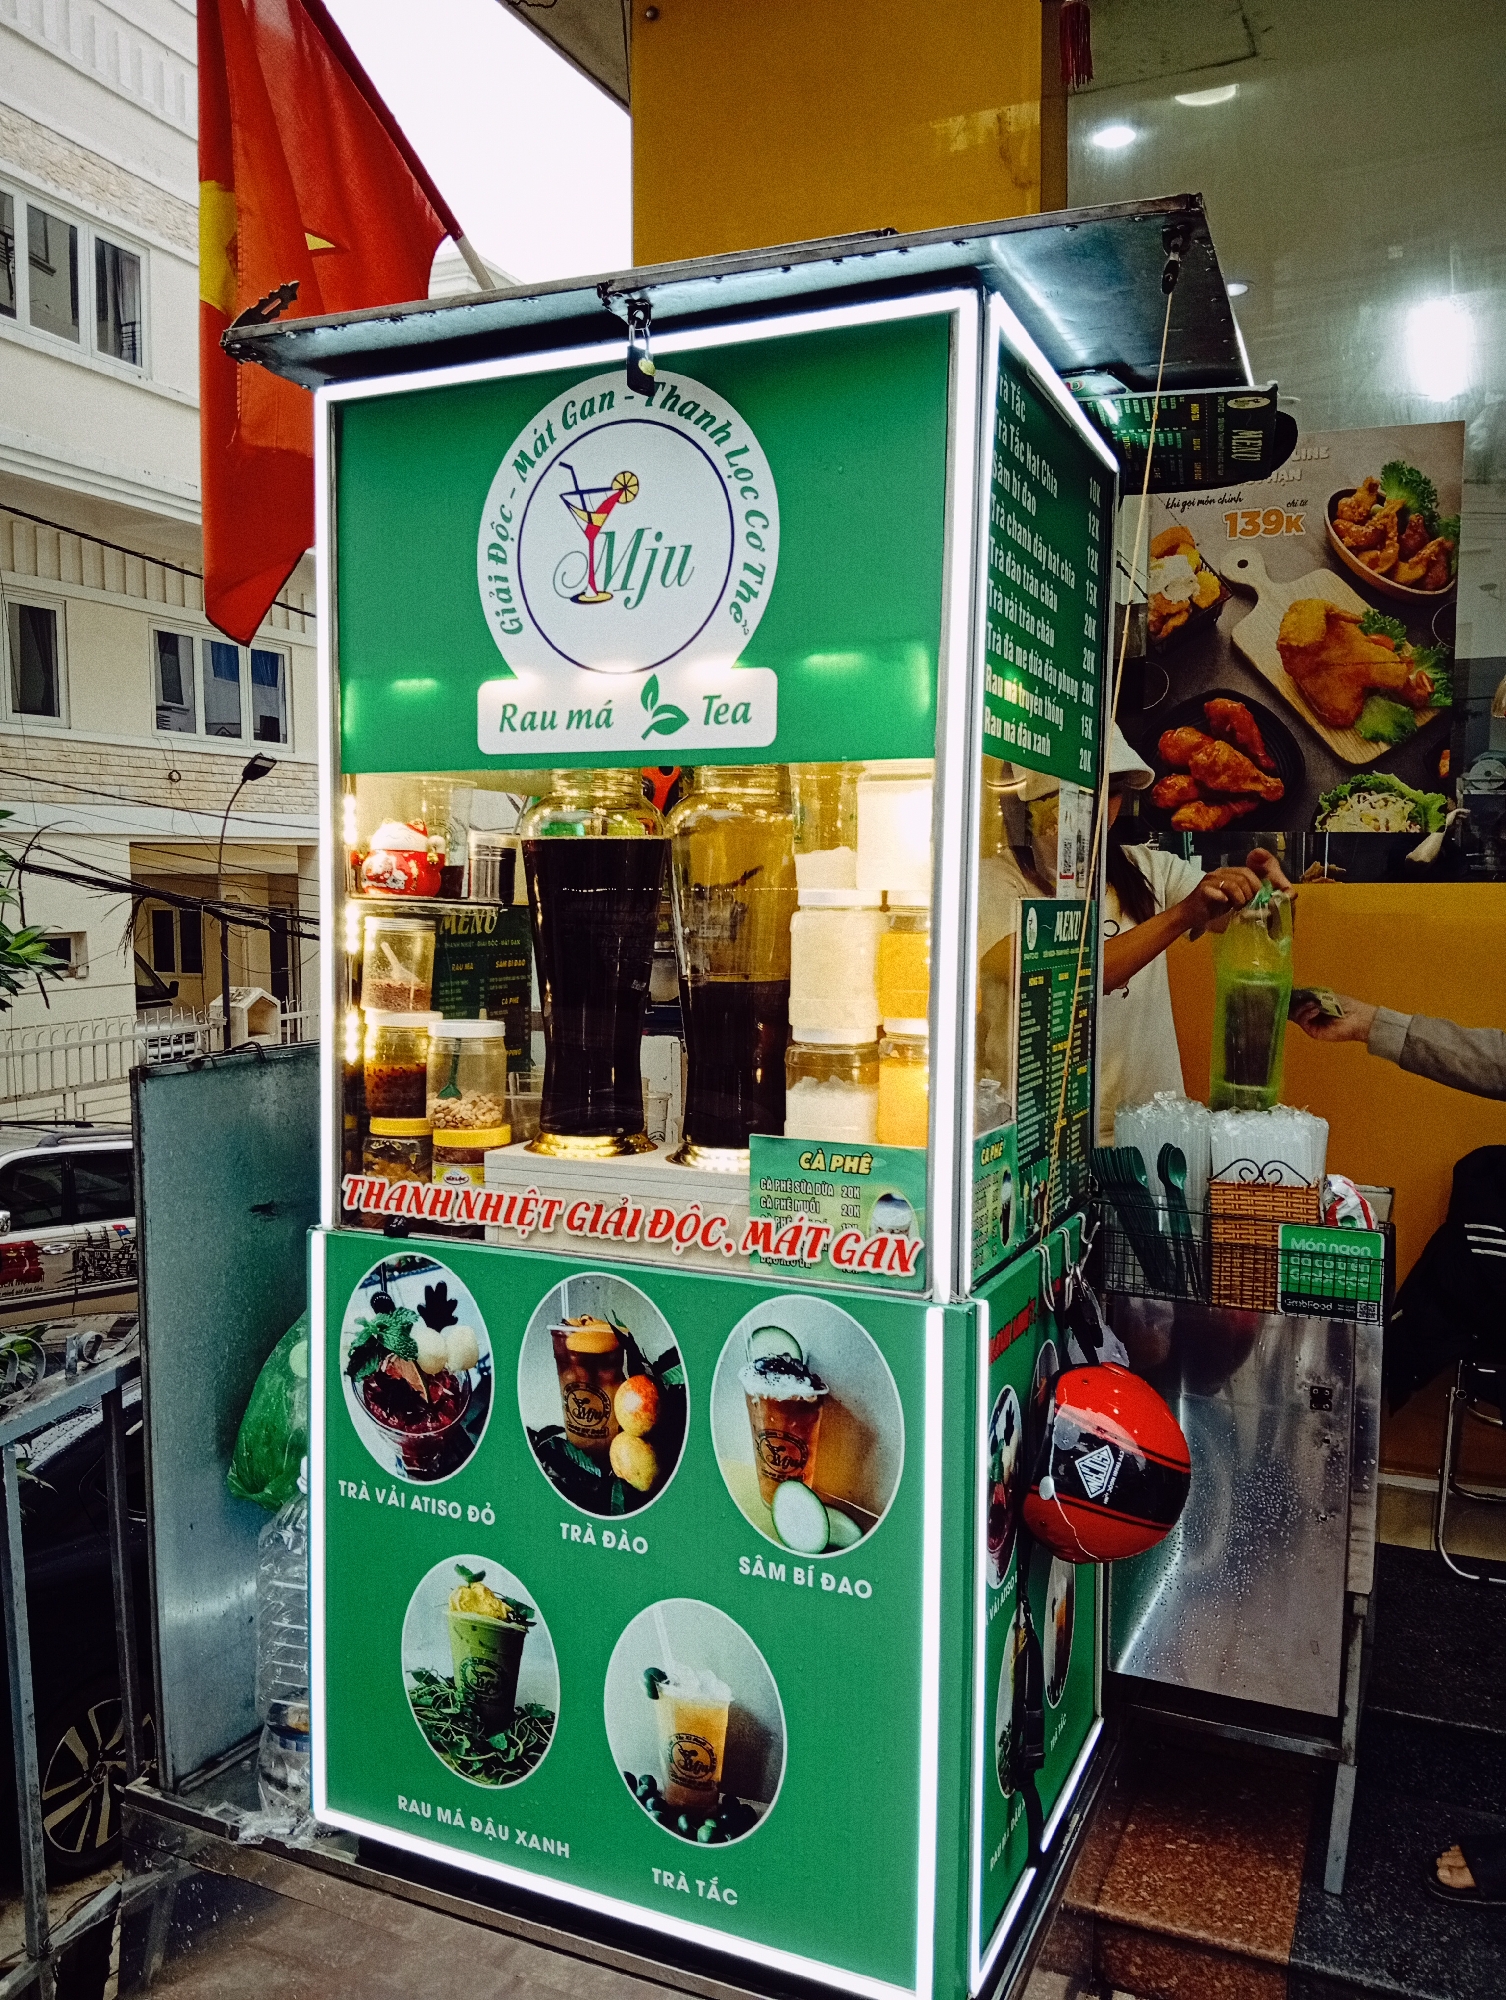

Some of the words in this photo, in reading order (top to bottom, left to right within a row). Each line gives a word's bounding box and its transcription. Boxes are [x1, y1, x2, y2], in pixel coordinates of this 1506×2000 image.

[561, 390, 615, 431] Gan
[645, 381, 732, 447] Thanh
[1011, 381, 1025, 422] Tắc
[512, 419, 557, 483] Mát
[1231, 430, 1263, 461] MENU
[724, 444, 759, 500] Lọc
[1010, 423, 1025, 463] Tắc
[1027, 442, 1040, 481] Hạt
[1042, 460, 1057, 499] Chia
[1088, 511, 1100, 542] 12K
[1165, 498, 1180, 509] khi
[1181, 501, 1195, 513] gọi
[487, 504, 515, 565] Độc
[744, 509, 770, 553] Cơ
[991, 492, 1004, 530] Trà
[1007, 512, 1031, 553] chanh
[1061, 559, 1075, 589] chia
[1086, 579, 1098, 608] 15K
[554, 527, 695, 610] Mju
[1087, 545, 1098, 575] 12K
[488, 574, 524, 635] Giải
[729, 562, 766, 636] Thể
[989, 535, 1004, 573] Trà
[1006, 550, 1021, 585] đào
[1084, 613, 1096, 641] 20K
[988, 578, 1002, 614] Trà
[1082, 647, 1095, 675] 20K
[987, 621, 1001, 655] Trà
[1004, 633, 1014, 662] đá
[1016, 645, 1027, 670] me
[1058, 668, 1078, 703] phụng
[1082, 681, 1094, 707] 20K
[499, 704, 557, 733] Rau
[565, 700, 614, 730] má
[702, 695, 752, 726] Tea
[985, 664, 1003, 698] Rau
[1004, 677, 1018, 705] má
[1081, 714, 1092, 740] 15K
[984, 706, 1002, 739] Rau
[1003, 718, 1016, 744] má
[1033, 733, 1050, 757] xanh
[1079, 748, 1092, 773] 20K
[439, 908, 498, 935] MENU
[1054, 910, 1081, 943] MENU
[799, 1148, 826, 1171] CÀ
[829, 1152, 873, 1175] PHÊ
[760, 1177, 773, 1191] CÀ
[774, 1178, 792, 1193] PHÊ
[841, 1186, 860, 1199] 20K
[760, 1195, 773, 1209] CÀ
[774, 1196, 792, 1211] PHÊ
[841, 1205, 860, 1218] 20K
[345, 1176, 453, 1219] THANH
[456, 1188, 563, 1235] NHIỆT
[567, 1197, 637, 1239] GIẢI
[742, 1216, 830, 1259] MÁT
[833, 1232, 919, 1273] GAN
[1290, 1238, 1326, 1252] Món
[338, 1480, 370, 1501] TRÀ
[375, 1485, 405, 1509] VẢI
[410, 1495, 462, 1519] ATISO
[467, 1502, 496, 1526] ĐỎ
[560, 1522, 597, 1546] TRÀ
[601, 1529, 649, 1555] ĐÀO
[738, 1554, 786, 1582] SÂM
[793, 1565, 815, 1588] BÍ
[820, 1572, 873, 1600] ĐAO
[397, 1794, 432, 1819] RAU
[437, 1807, 466, 1829] MÁ
[471, 1816, 509, 1842] ĐẬU
[515, 1828, 570, 1858] XANH
[652, 1867, 690, 1894] TRÀ
[695, 1876, 738, 1906] TẮC
